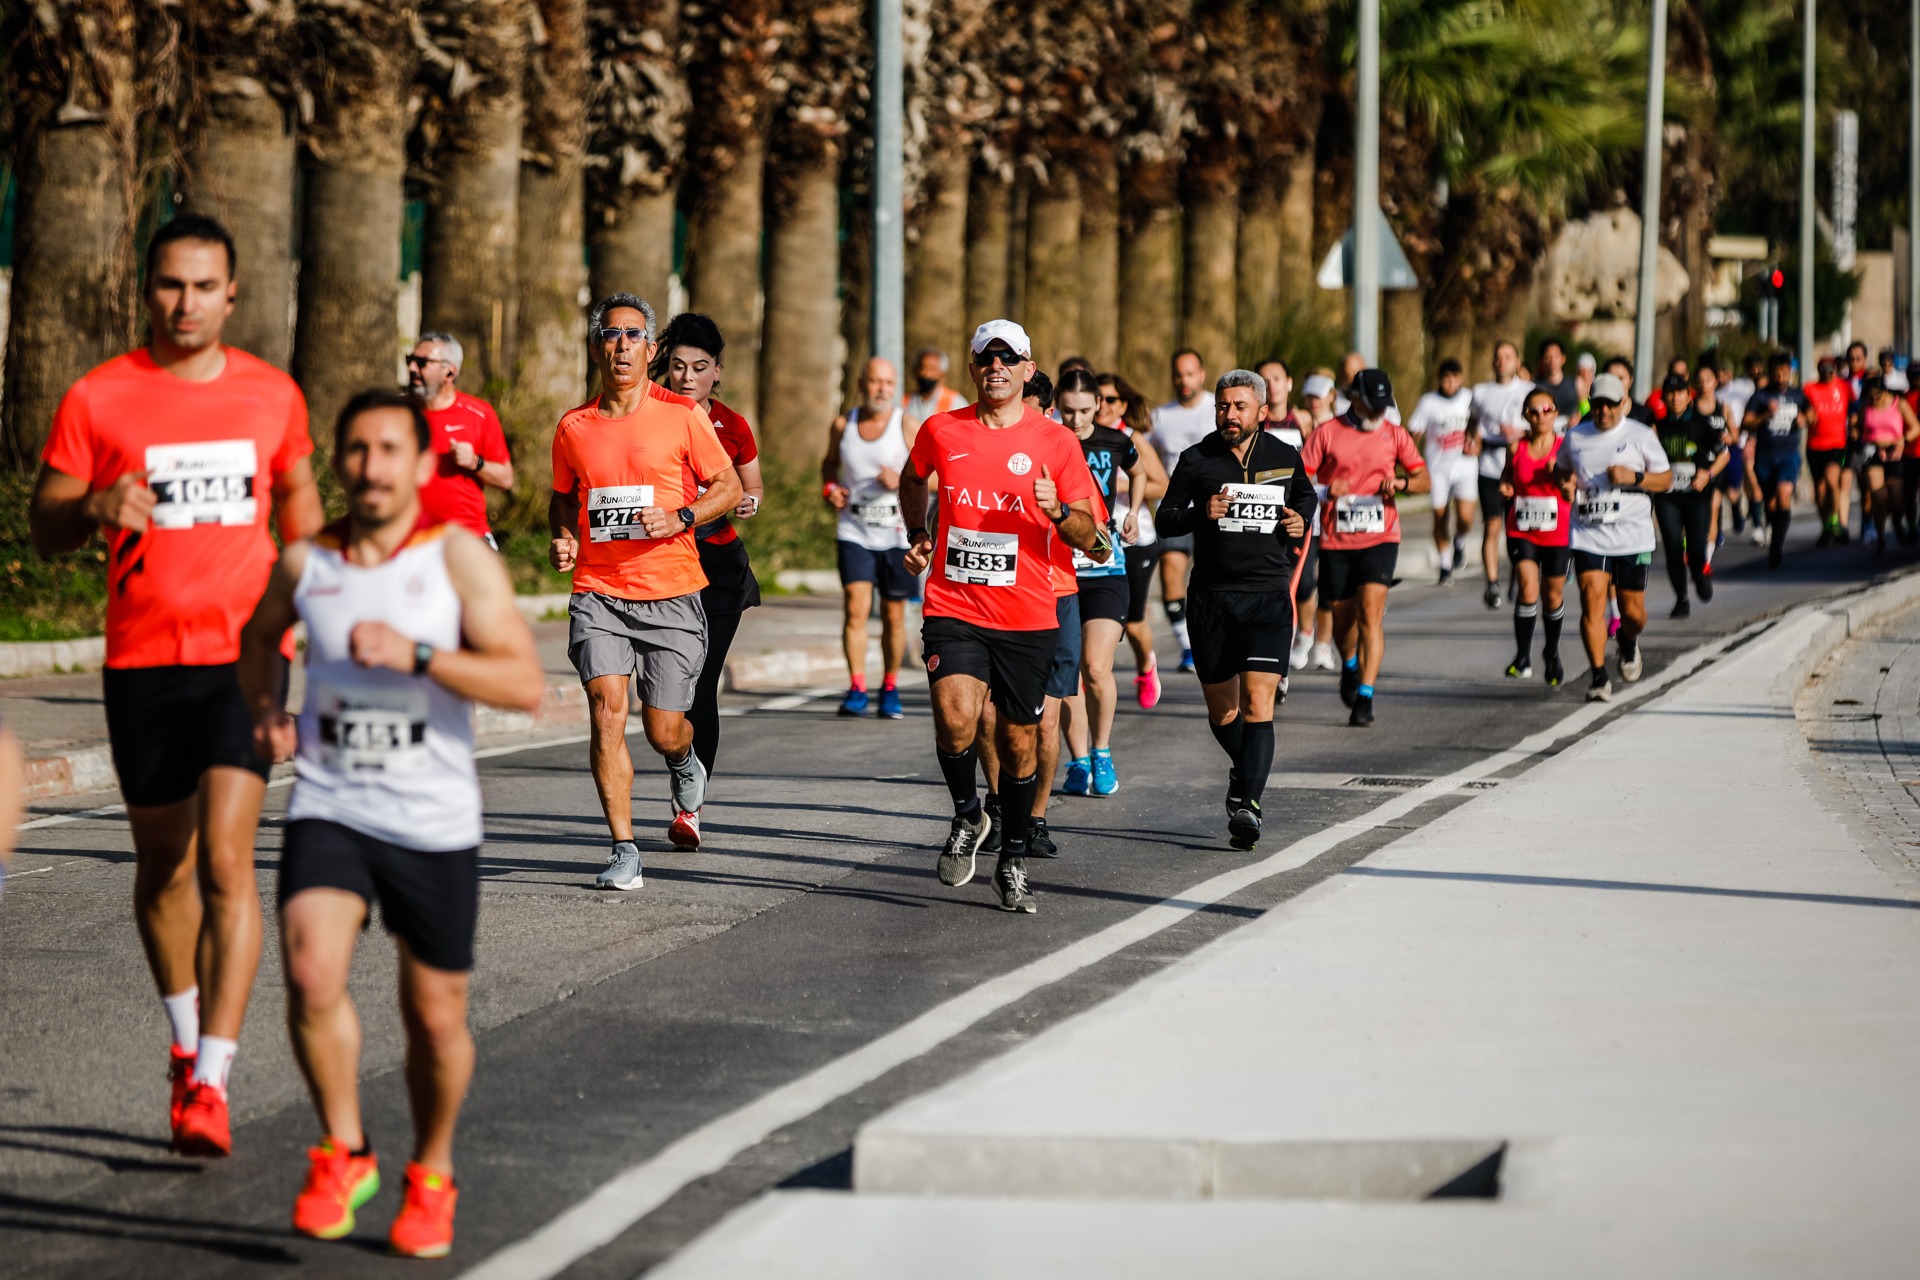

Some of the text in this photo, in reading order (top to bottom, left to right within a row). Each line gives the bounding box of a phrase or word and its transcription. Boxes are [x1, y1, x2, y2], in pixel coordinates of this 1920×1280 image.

[165, 478, 248, 505] 1045
[601, 495, 642, 505] RUNATOLIA
[944, 485, 1025, 514] TALYA
[1237, 491, 1276, 501] RUNATOLIA
[1230, 503, 1278, 520] 1484
[963, 537, 1007, 551] RUNATOLIA
[956, 551, 1008, 572] 1533
